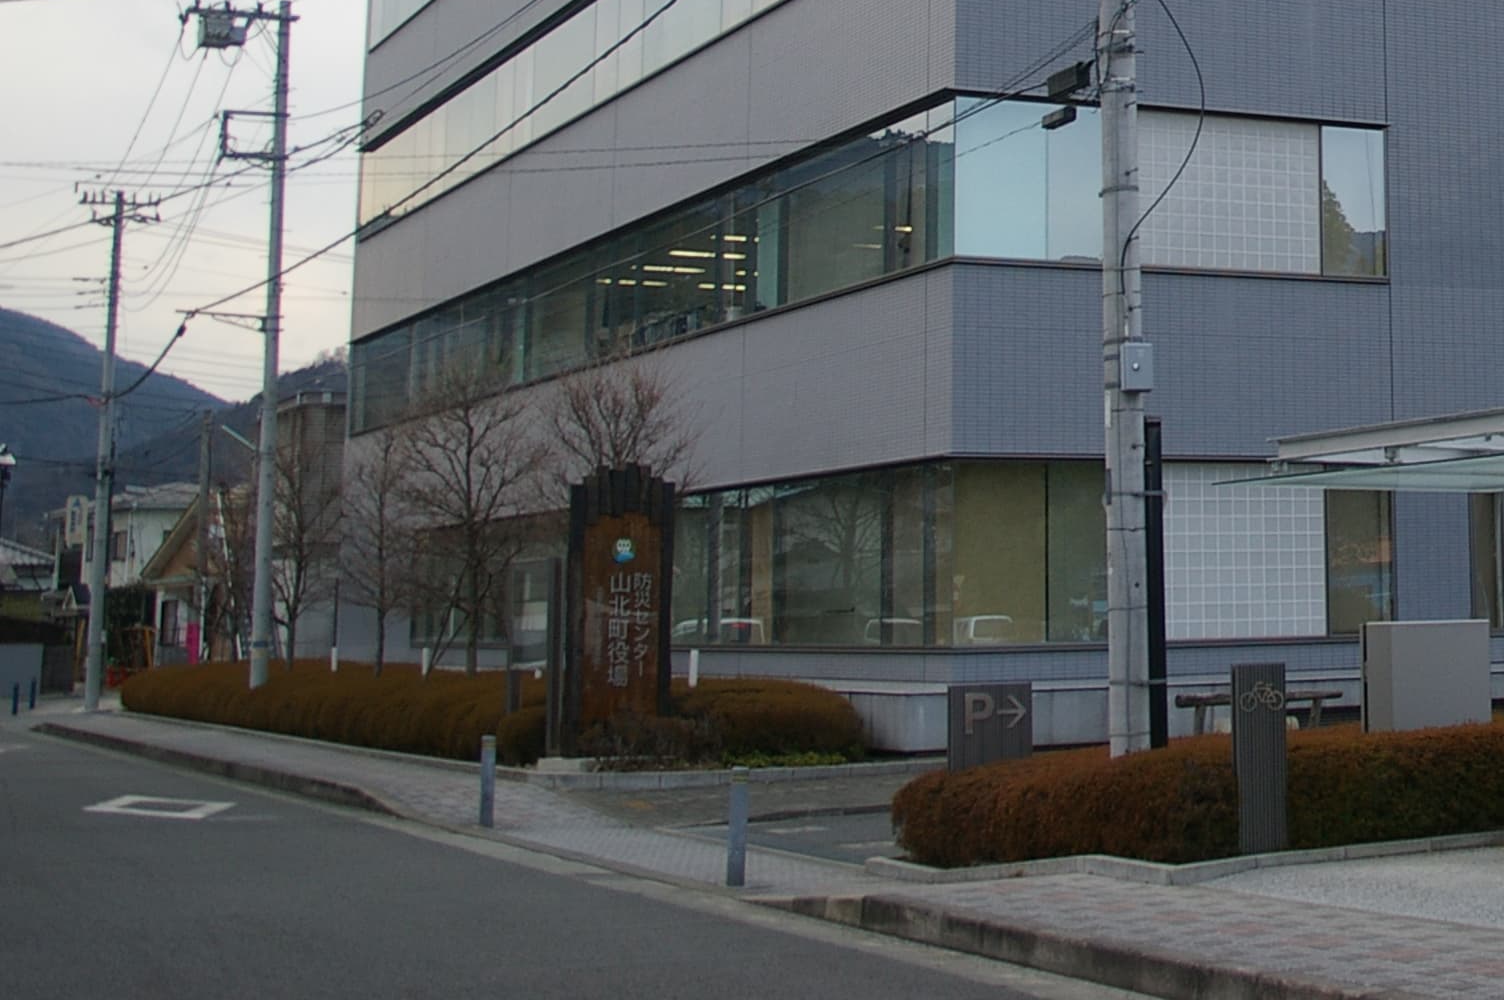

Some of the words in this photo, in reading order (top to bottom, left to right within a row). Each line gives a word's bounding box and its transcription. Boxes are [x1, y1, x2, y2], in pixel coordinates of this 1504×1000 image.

[608, 571, 631, 687] 山北町役場
[633, 572, 652, 677] 防災センター
[965, 692, 993, 735] P
